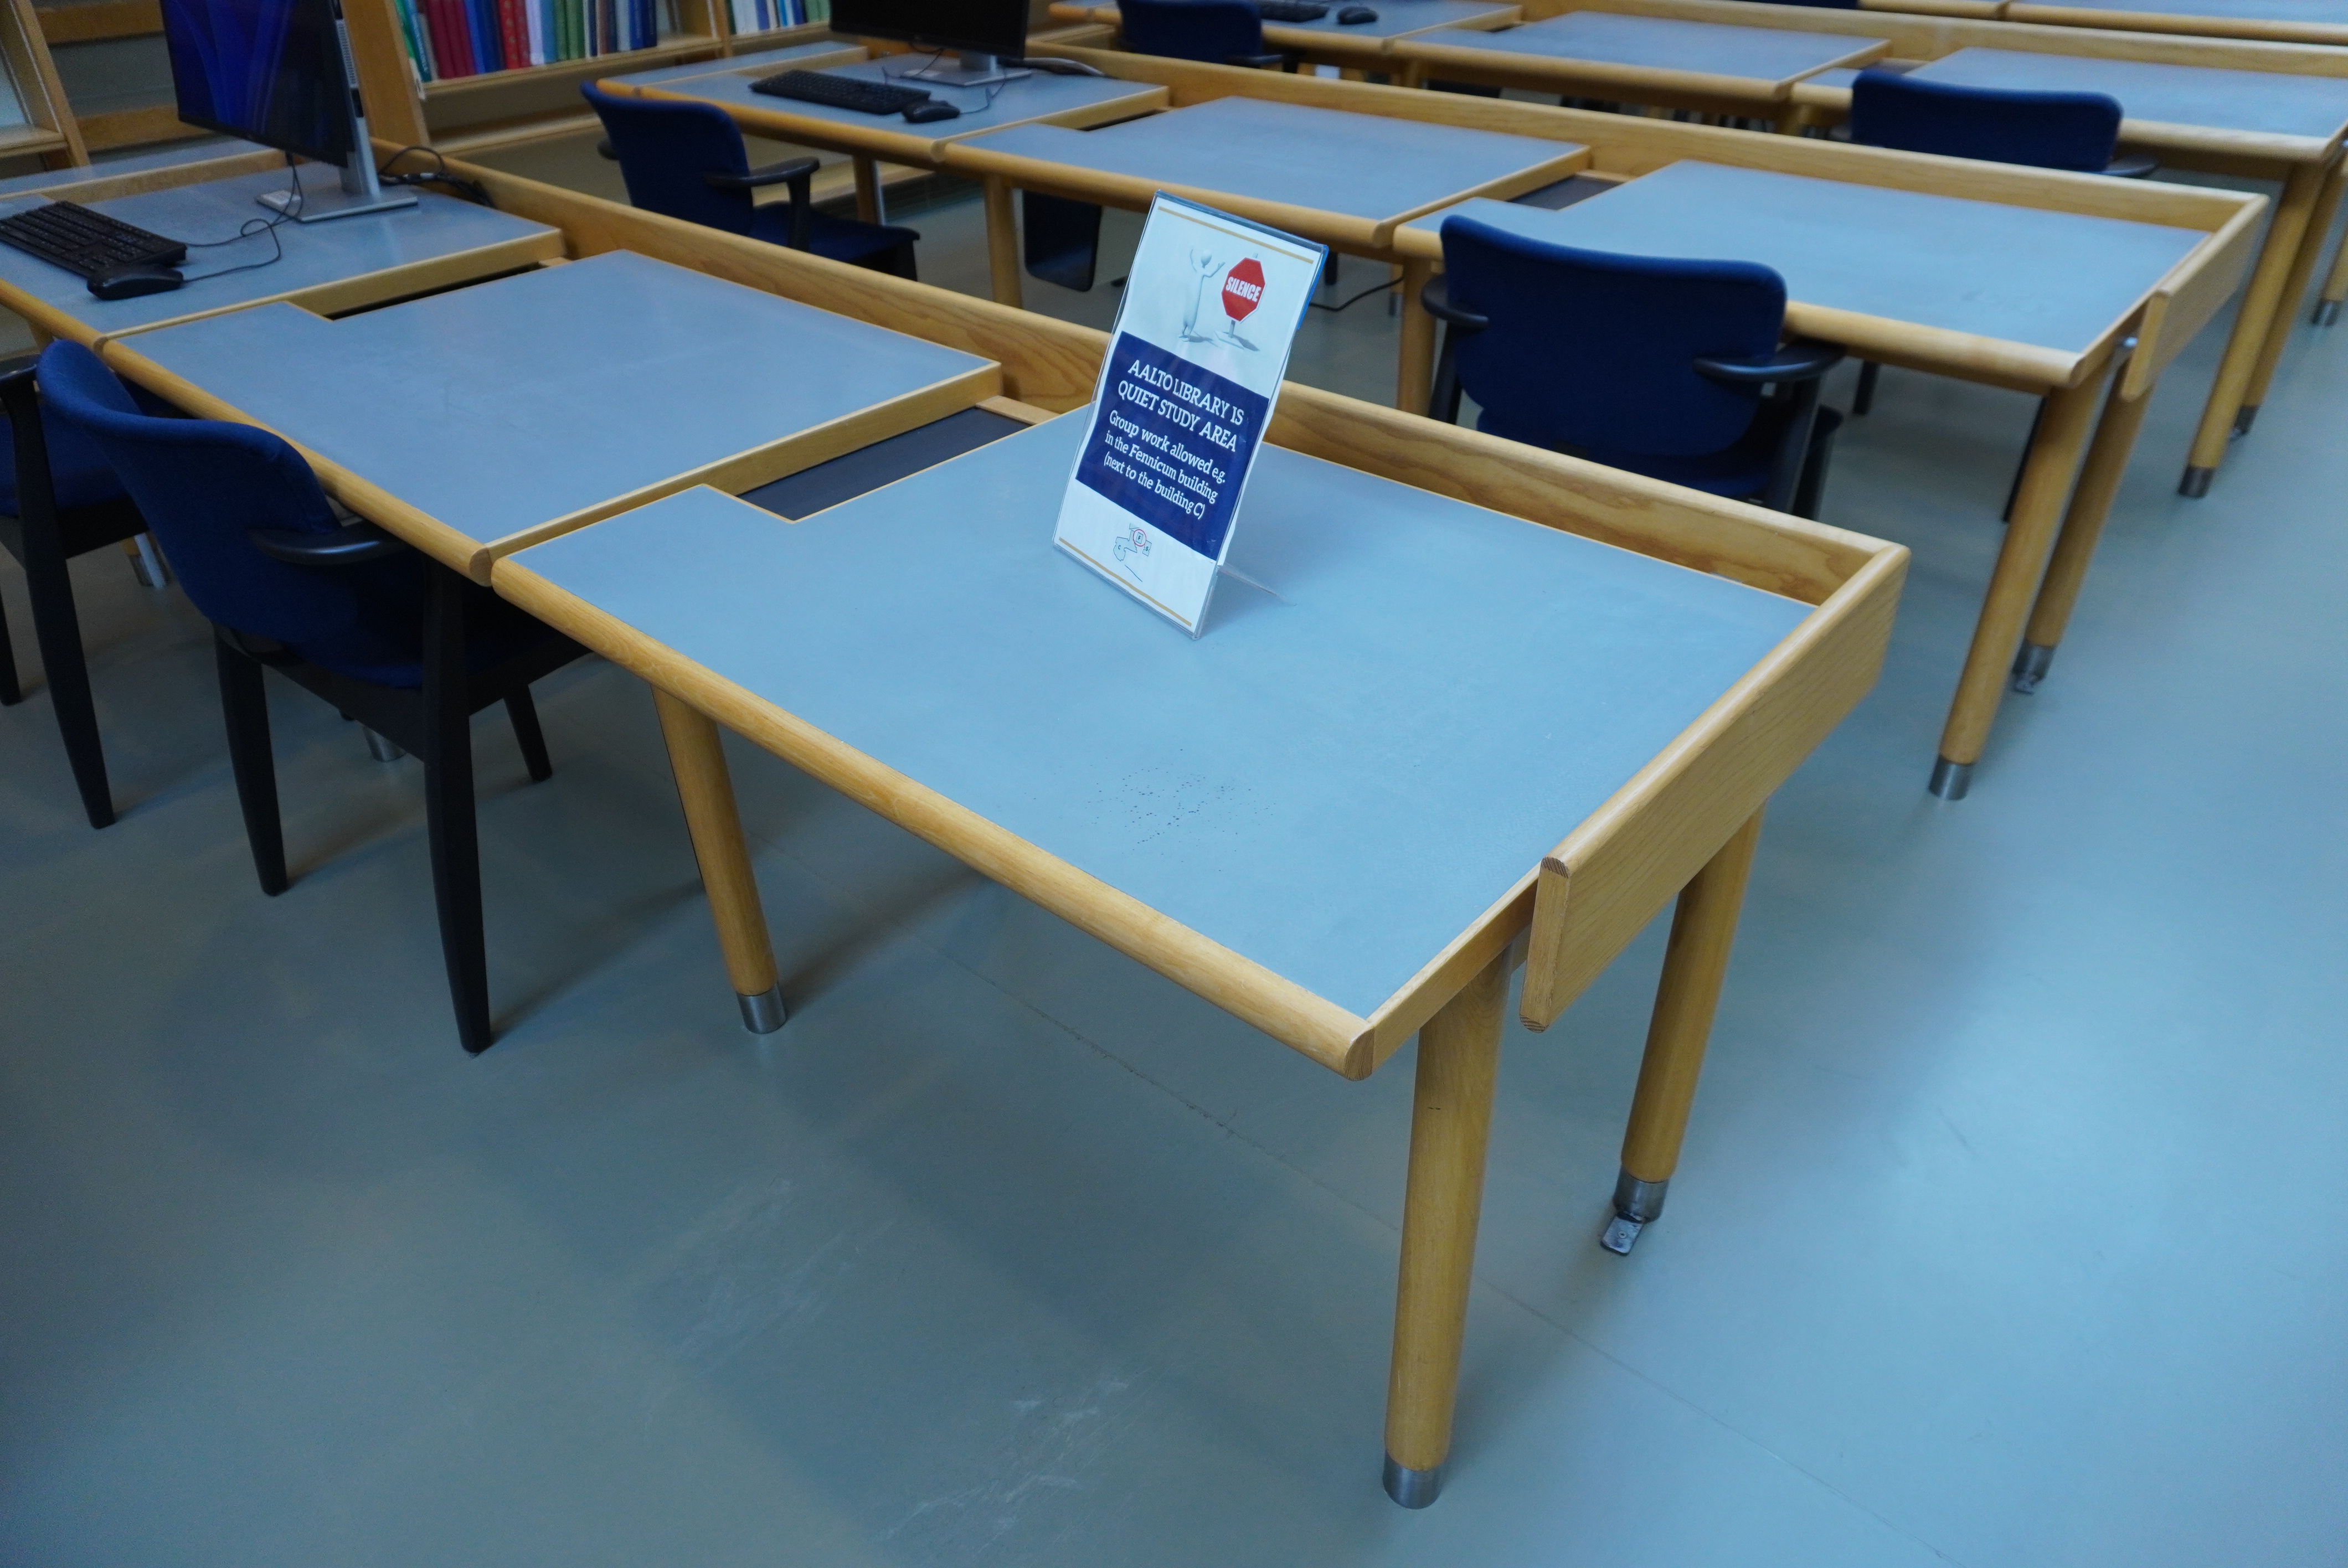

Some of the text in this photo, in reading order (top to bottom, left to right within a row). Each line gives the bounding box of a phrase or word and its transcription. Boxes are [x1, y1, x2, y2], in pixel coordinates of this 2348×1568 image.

[1226, 276, 1261, 302] SILENCE
[1118, 380, 1238, 452] QUIET STUDY AREA
[1127, 359, 1244, 426] AALTO LIBRARY IS
[1105, 430, 1218, 504] in the Fennicum building
[1109, 410, 1226, 484] Group work allowed e.g.
[1104, 451, 1206, 520] (next to the building C)
